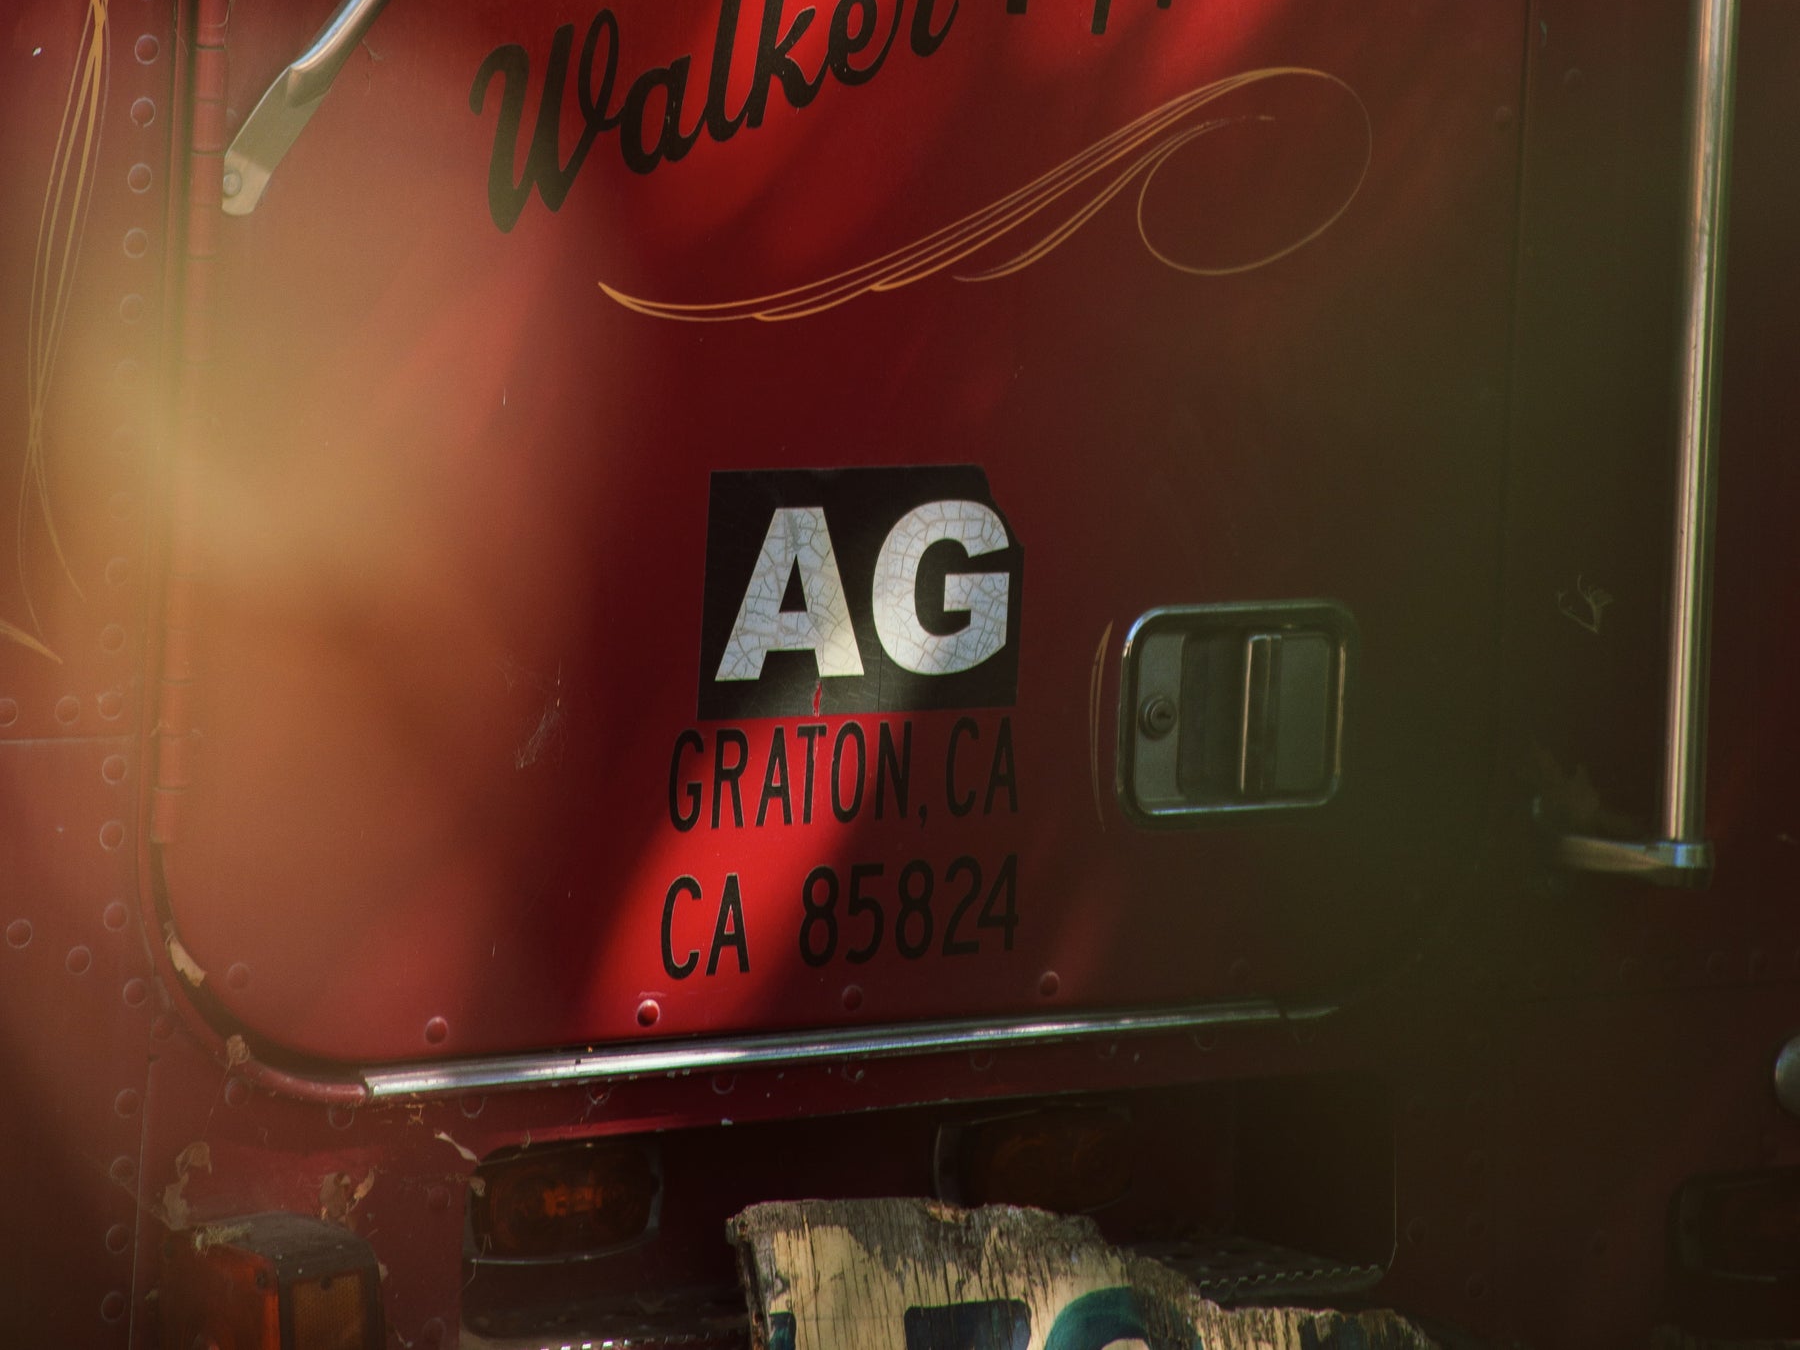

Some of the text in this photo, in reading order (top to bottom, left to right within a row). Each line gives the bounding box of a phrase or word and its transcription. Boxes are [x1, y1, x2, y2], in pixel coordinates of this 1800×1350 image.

[715, 500, 1010, 681] AG
[668, 716, 1019, 833] GRATON, CA
[660, 854, 1020, 979] CA 85824
